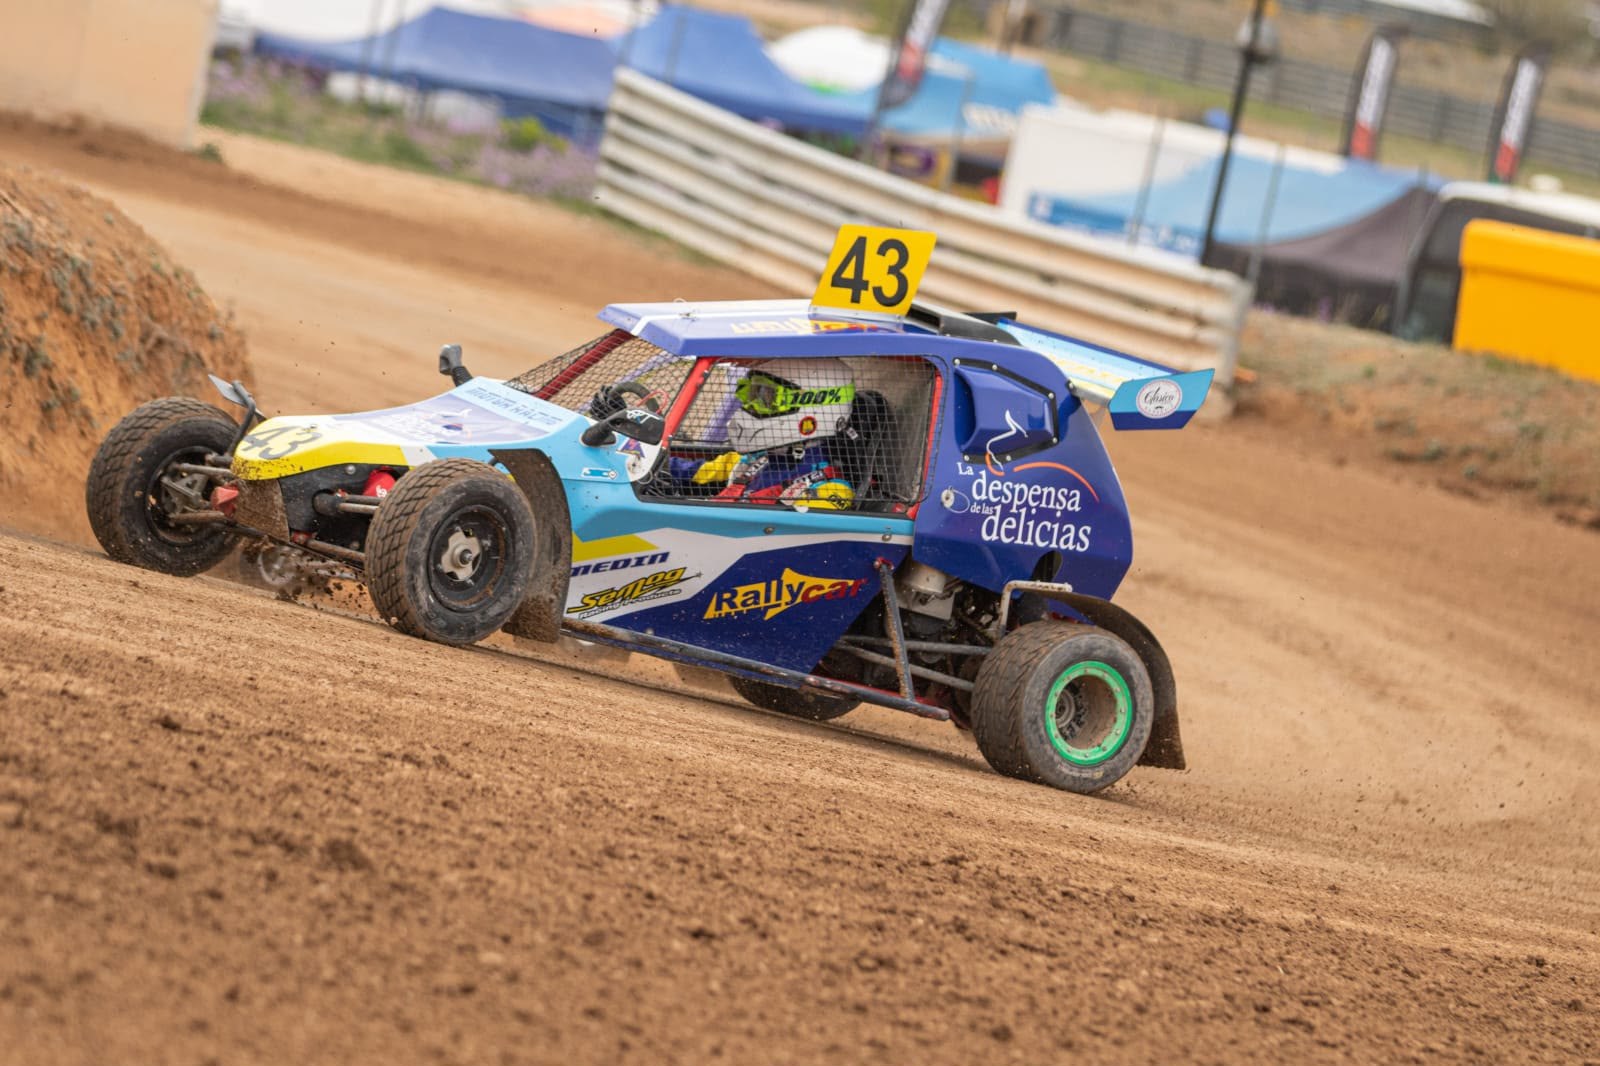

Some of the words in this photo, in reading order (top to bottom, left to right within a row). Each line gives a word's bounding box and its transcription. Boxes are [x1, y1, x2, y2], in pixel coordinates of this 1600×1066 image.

[830, 236, 909, 307] 43
[789, 388, 842, 406] 100%
[241, 426, 322, 460] 43
[957, 462, 974, 475] La
[970, 503, 981, 514] de
[981, 503, 995, 515] las
[972, 470, 1082, 513] despensa
[981, 505, 1091, 552] delicias
[712, 577, 868, 614] Rallycar
